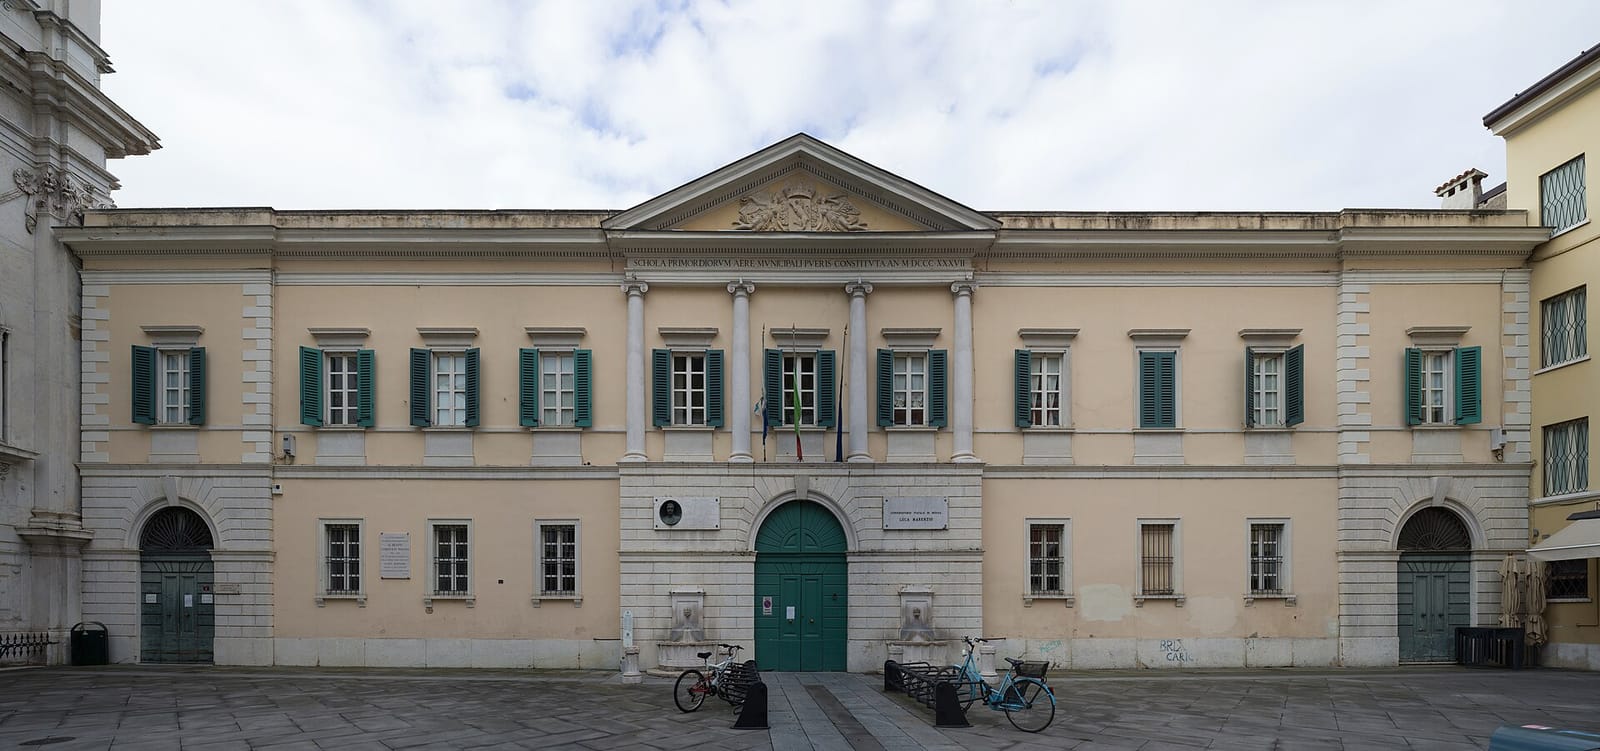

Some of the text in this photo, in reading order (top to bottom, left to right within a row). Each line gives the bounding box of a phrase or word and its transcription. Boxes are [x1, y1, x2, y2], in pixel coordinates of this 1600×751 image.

[633, 258, 666, 267] SCHOLA
[668, 258, 731, 267] PRIMORDIORVM
[735, 259, 755, 267] AERE
